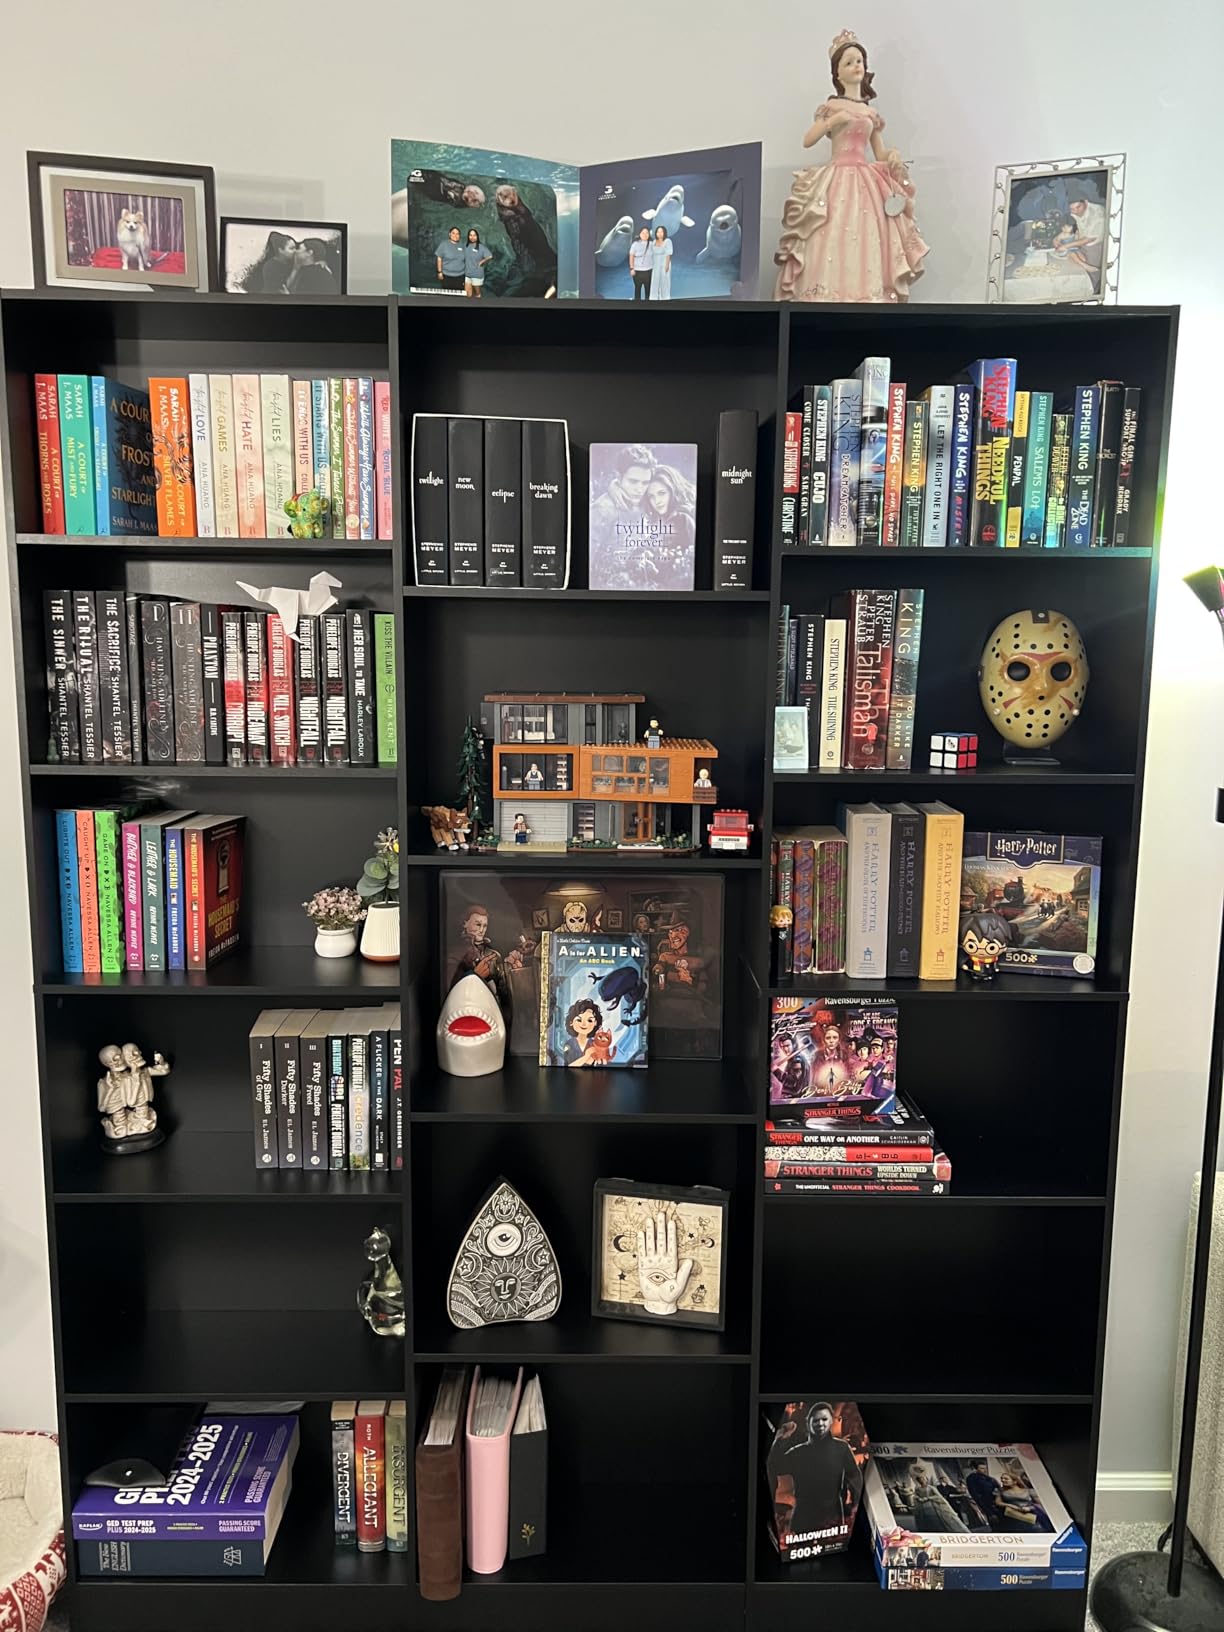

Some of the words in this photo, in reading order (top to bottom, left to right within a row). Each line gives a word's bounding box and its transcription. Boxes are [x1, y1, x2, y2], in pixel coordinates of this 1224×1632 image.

[38, 391, 48, 420] MAAS
[48, 385, 57, 419] SARAH
[64, 391, 73, 420] MAAS
[74, 384, 83, 418] SARAH
[110, 398, 117, 412] A
[170, 388, 179, 421] SARAH
[804, 401, 812, 423] COME
[892, 388, 903, 437] STEPHEN
[1038, 395, 1047, 427] STEPHEN
[1080, 390, 1092, 440] STEPHEN
[195, 415, 205, 441] LOVE
[271, 418, 281, 442] LIES
[816, 399, 828, 440] STEPHEN
[958, 392, 970, 442] STEPHEN
[216, 416, 227, 452] GAMES
[241, 421, 253, 451] HATE
[299, 427, 309, 453] WITH
[803, 427, 811, 456] CLOSER
[912, 422, 922, 466] STEPHEN
[937, 425, 945, 439] LET
[40, 432, 49, 470] THORNS
[67, 437, 75, 461] MIST
[299, 454, 309, 465] US
[785, 448, 798, 473] STEPHEN
[815, 440, 827, 462] KING
[890, 437, 901, 464] KING
[936, 443, 944, 459] THE
[955, 446, 968, 478] KING
[1078, 443, 1090, 470] KING
[52, 456, 61, 492] COURT
[78, 452, 87, 487] COURT
[318, 458, 327, 470] US
[419, 471, 444, 486] twilight
[722, 466, 752, 480] midnight
[935, 462, 943, 487] RIGHT
[975, 443, 992, 501] THINGS
[990, 436, 1011, 505] NEEDFUL
[1012, 455, 1023, 486] PENPAL
[530, 482, 558, 493] breaking
[783, 473, 797, 488] KING
[813, 471, 826, 504] CUJO
[840, 453, 850, 530] DREAMCATCHER
[910, 468, 920, 493] KING
[44, 484, 52, 514] ROSES
[164, 489, 174, 526] FLAMES
[177, 483, 185, 517] COURT
[492, 490, 515, 503] eclipse
[934, 491, 942, 508] ONE
[616, 515, 673, 539] twilight
[932, 511, 940, 520] IN
[625, 537, 663, 548] forever
[51, 599, 64, 621] THE
[76, 597, 89, 622] THE
[106, 598, 118, 616] THE
[857, 594, 868, 644] STRAUB
[876, 595, 885, 625] KING
[882, 594, 893, 648] STEPHEN
[225, 622, 236, 653] PENELOPE
[326, 619, 337, 649] PENELOPE
[353, 629, 364, 646] HER
[384, 621, 392, 636] KISS
[866, 605, 876, 643] PETER
[899, 602, 914, 654] KING
[52, 629, 66, 670] SINNER
[106, 620, 121, 672] SACRIFICE
[203, 636, 218, 679] PHANTOM
[354, 647, 364, 668] SOUL
[384, 637, 392, 649] THE
[829, 638, 840, 672] STEPHEN
[327, 650, 338, 678] DOUGLAS
[805, 661, 813, 681] KING
[354, 678, 365, 697] TAKE
[828, 673, 838, 691] KING
[58, 677, 68, 718] SHANTEL
[83, 677, 93, 719] SHANTEL
[111, 677, 120, 717] SHANTEL
[273, 695, 290, 712] KILL
[226, 702, 244, 743] CORRUPT
[247, 701, 266, 745] HIDEAWAY
[274, 715, 290, 746] SWITCH
[299, 696, 319, 747] NIGHTFALL
[326, 696, 346, 746] NIGHTFALL
[827, 712, 837, 741] SHINING
[894, 712, 902, 748] DARKER
[60, 721, 70, 757] TESSIER
[85, 722, 95, 759] TESSIER
[113, 720, 123, 757] TESSIER
[904, 725, 912, 748] LIKE
[126, 832, 137, 861] BUTCHER
[145, 840, 157, 868] LEATHER
[995, 839, 1025, 856] Harry
[1026, 838, 1057, 856] Potter
[168, 849, 179, 889] HOUSEMAID
[871, 842, 879, 887] HARRY
[907, 841, 915, 886] HARRY
[944, 842, 953, 887] HARRY
[147, 878, 158, 897] LARK
[868, 890, 878, 933] POTTER
[904, 890, 913, 935] POTTER
[942, 891, 951, 934] POTTER
[559, 946, 568, 956] A
[587, 946, 640, 957] ALIEN
[1006, 953, 1028, 962] 500
[776, 997, 798, 1009] 300
[352, 1038, 363, 1066] PENELOPE
[262, 1060, 271, 1082] Fifty
[286, 1060, 295, 1082] Fifty
[312, 1062, 321, 1084] Fifty
[263, 1083, 272, 1114] Shades
[288, 1083, 297, 1114] Shades
[313, 1085, 322, 1117] Shades
[331, 1104, 342, 1132] PENELOPE
[354, 1096, 364, 1151] credence
[804, 1135, 819, 1143] ONE
[820, 1135, 835, 1143] WAY
[846, 1135, 880, 1143] ANOTHER
[783, 1167, 834, 1176] STRANGER
[836, 1167, 873, 1176] THINGS
[167, 1424, 223, 1506] 2024-2025
[337, 1452, 350, 1523] DIVERGENT
[363, 1446, 377, 1528] ALLEGIANT
[392, 1445, 406, 1527] INSURGENT
[785, 1526, 839, 1545] HALLOWEEN
[840, 1525, 848, 1534] II
[939, 1535, 1024, 1545] BRIDGERTON
[790, 1547, 811, 1560] 500
[998, 1552, 1015, 1561] 500
[1000, 1575, 1018, 1584] 500
